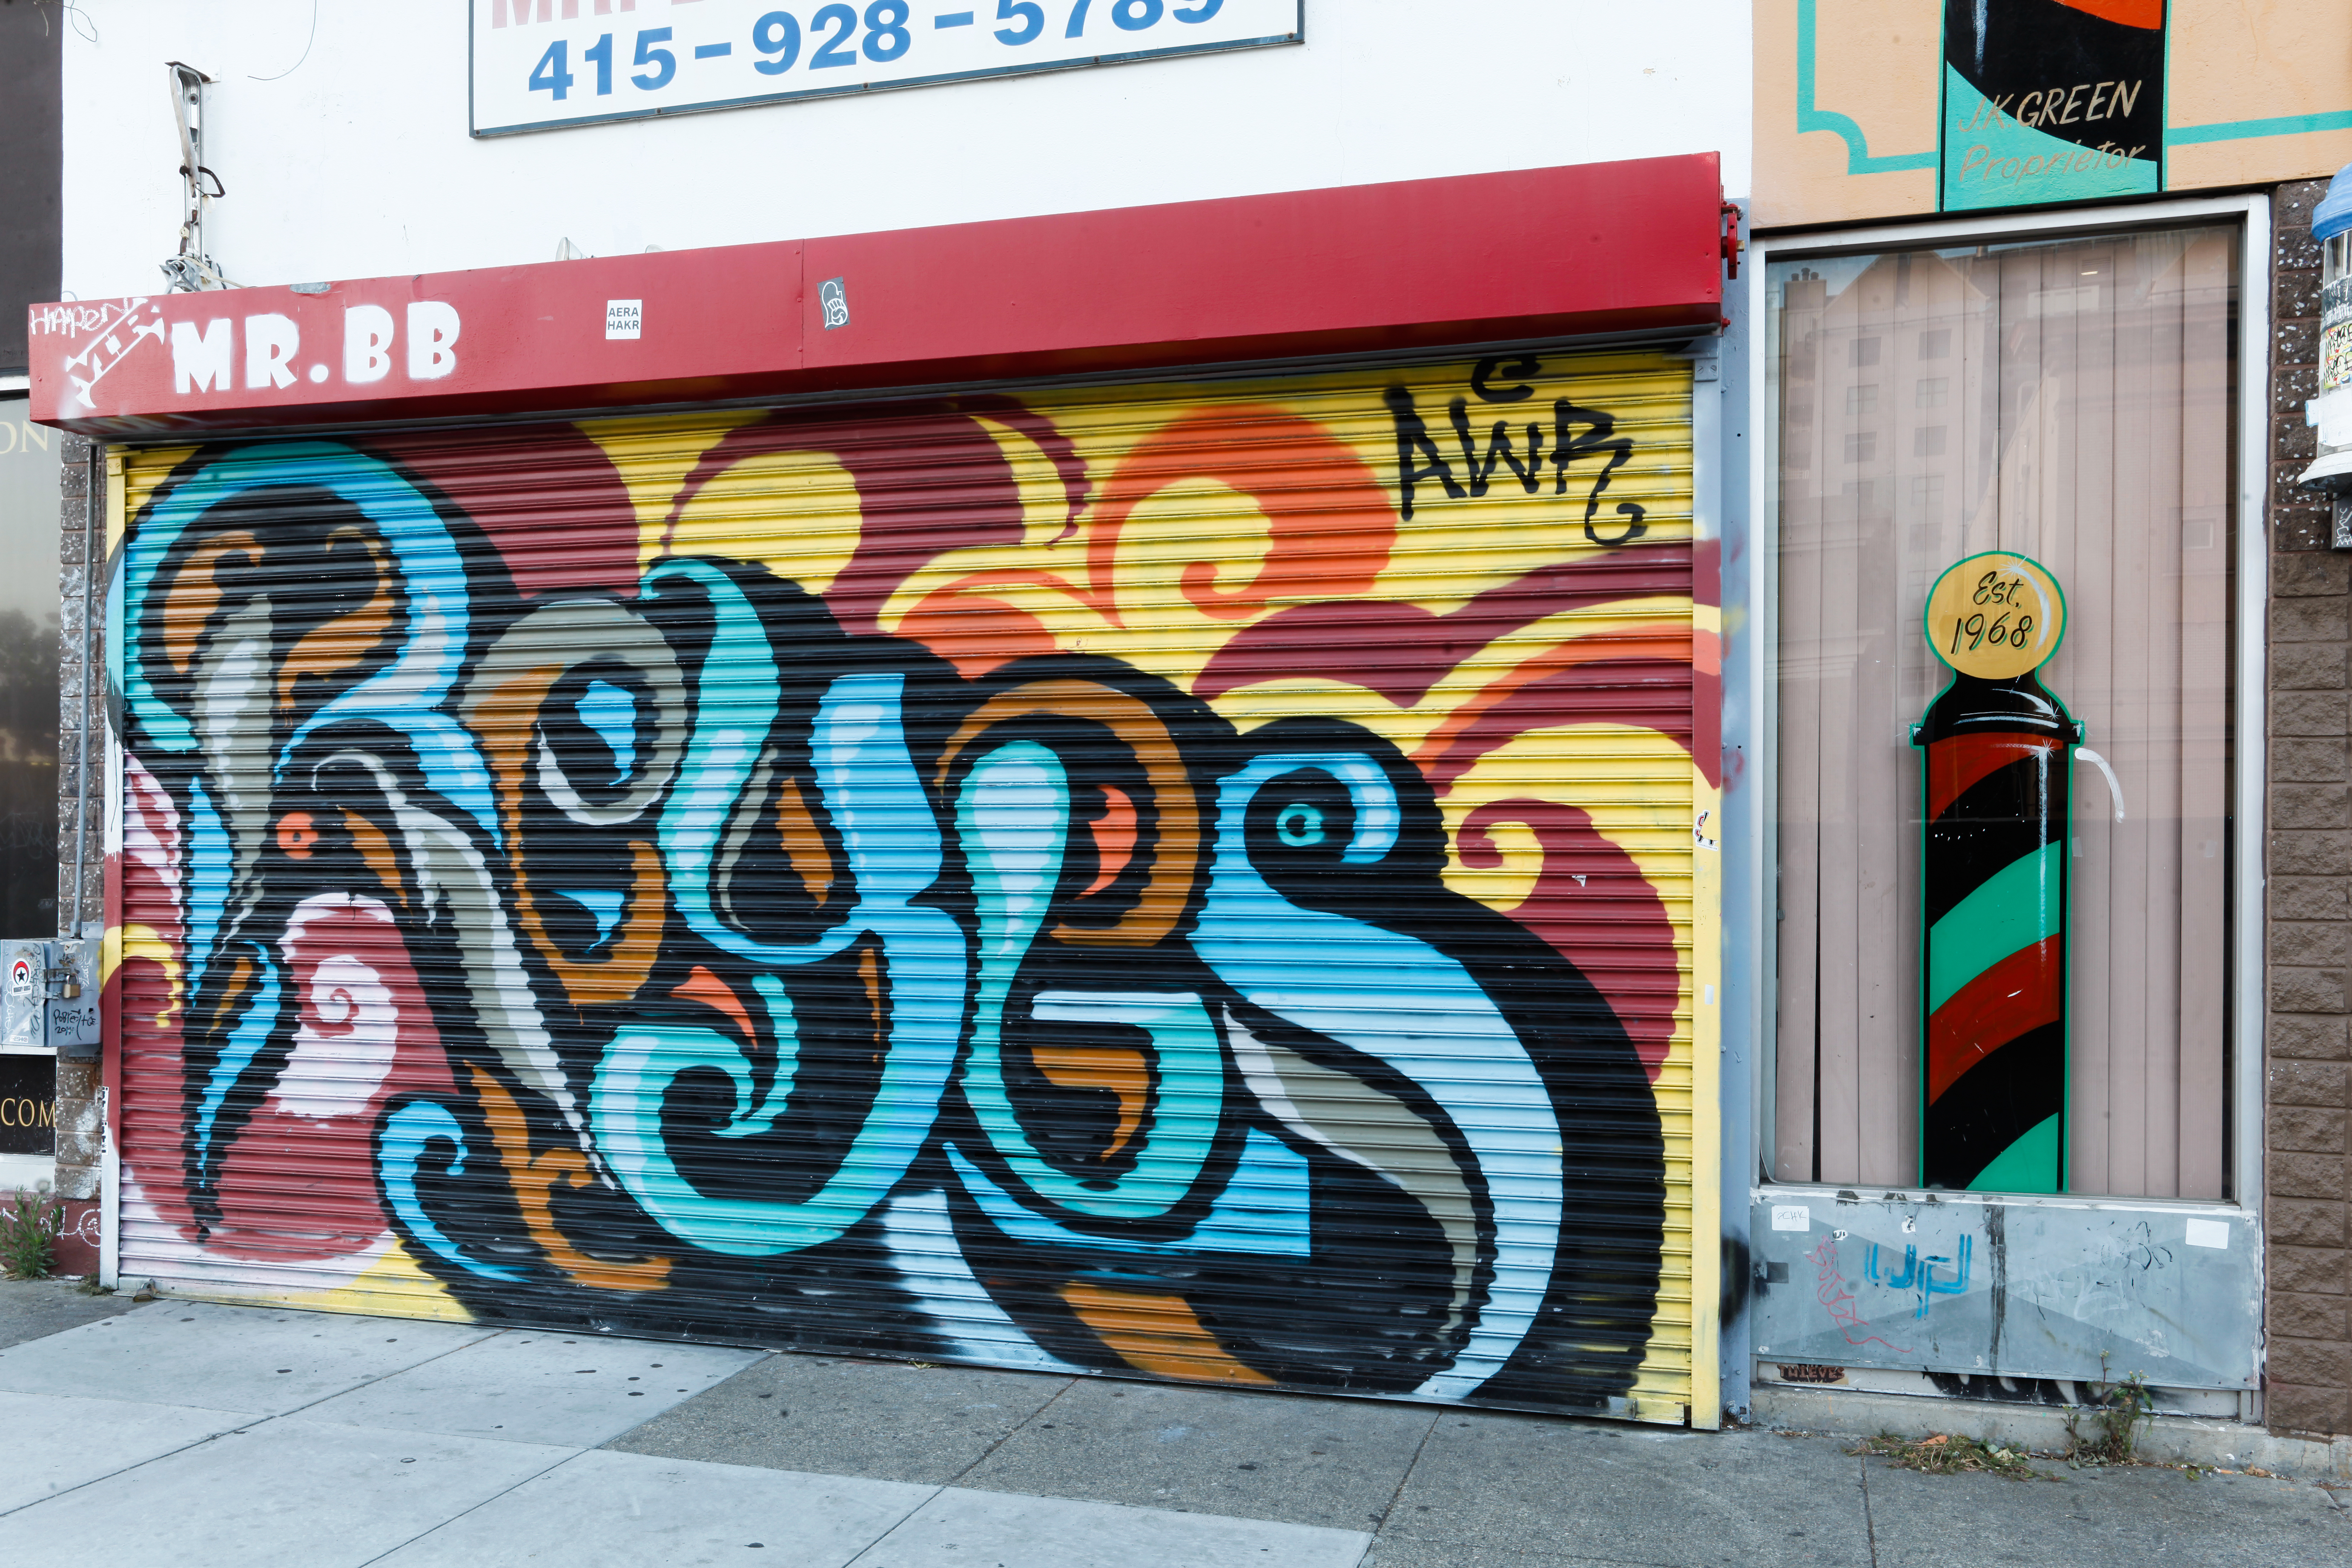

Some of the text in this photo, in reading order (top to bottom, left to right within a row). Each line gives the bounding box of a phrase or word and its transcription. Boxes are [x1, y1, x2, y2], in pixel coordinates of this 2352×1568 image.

[2016, 80, 2142, 127] GREEN
[1959, 139, 2145, 186] Proprietor
[608, 307, 639, 317] AERA
[608, 320, 640, 330] HAKR
[171, 301, 461, 394] MR. BB
[1950, 611, 2032, 654] 1968
[1, 1098, 56, 1127] COM
[1777, 1364, 1845, 1379] THIEVES
